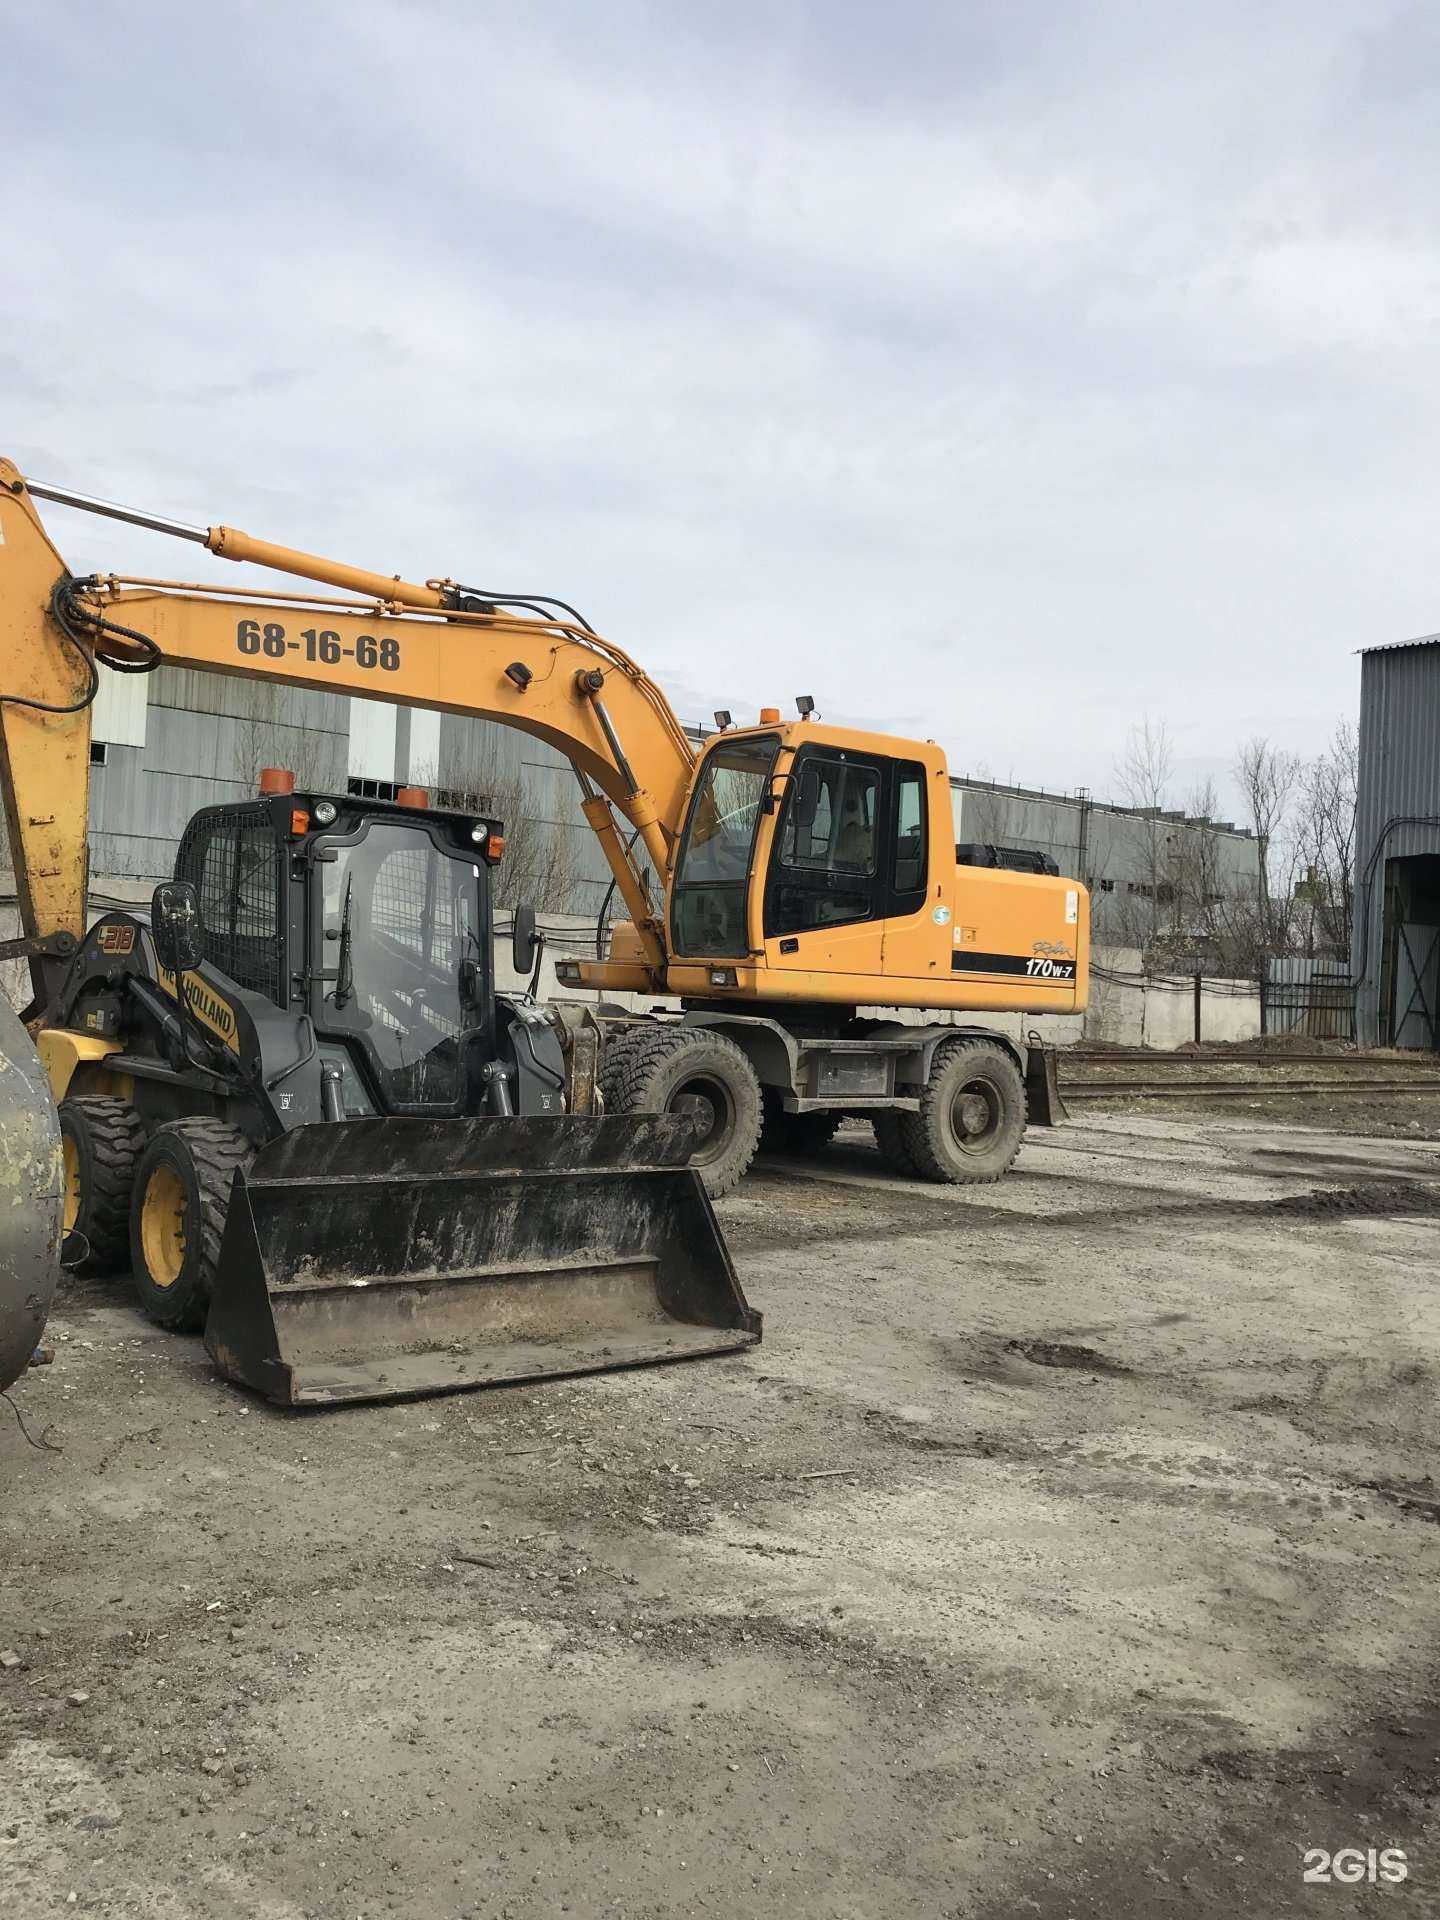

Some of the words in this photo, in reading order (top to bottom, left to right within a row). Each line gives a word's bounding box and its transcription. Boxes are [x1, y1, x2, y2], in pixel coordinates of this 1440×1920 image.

[237, 619, 400, 671] 68-16-68
[97, 926, 135, 954] L218
[1026, 958, 1073, 978] 170W-7
[185, 978, 231, 1032] HOLLAND
